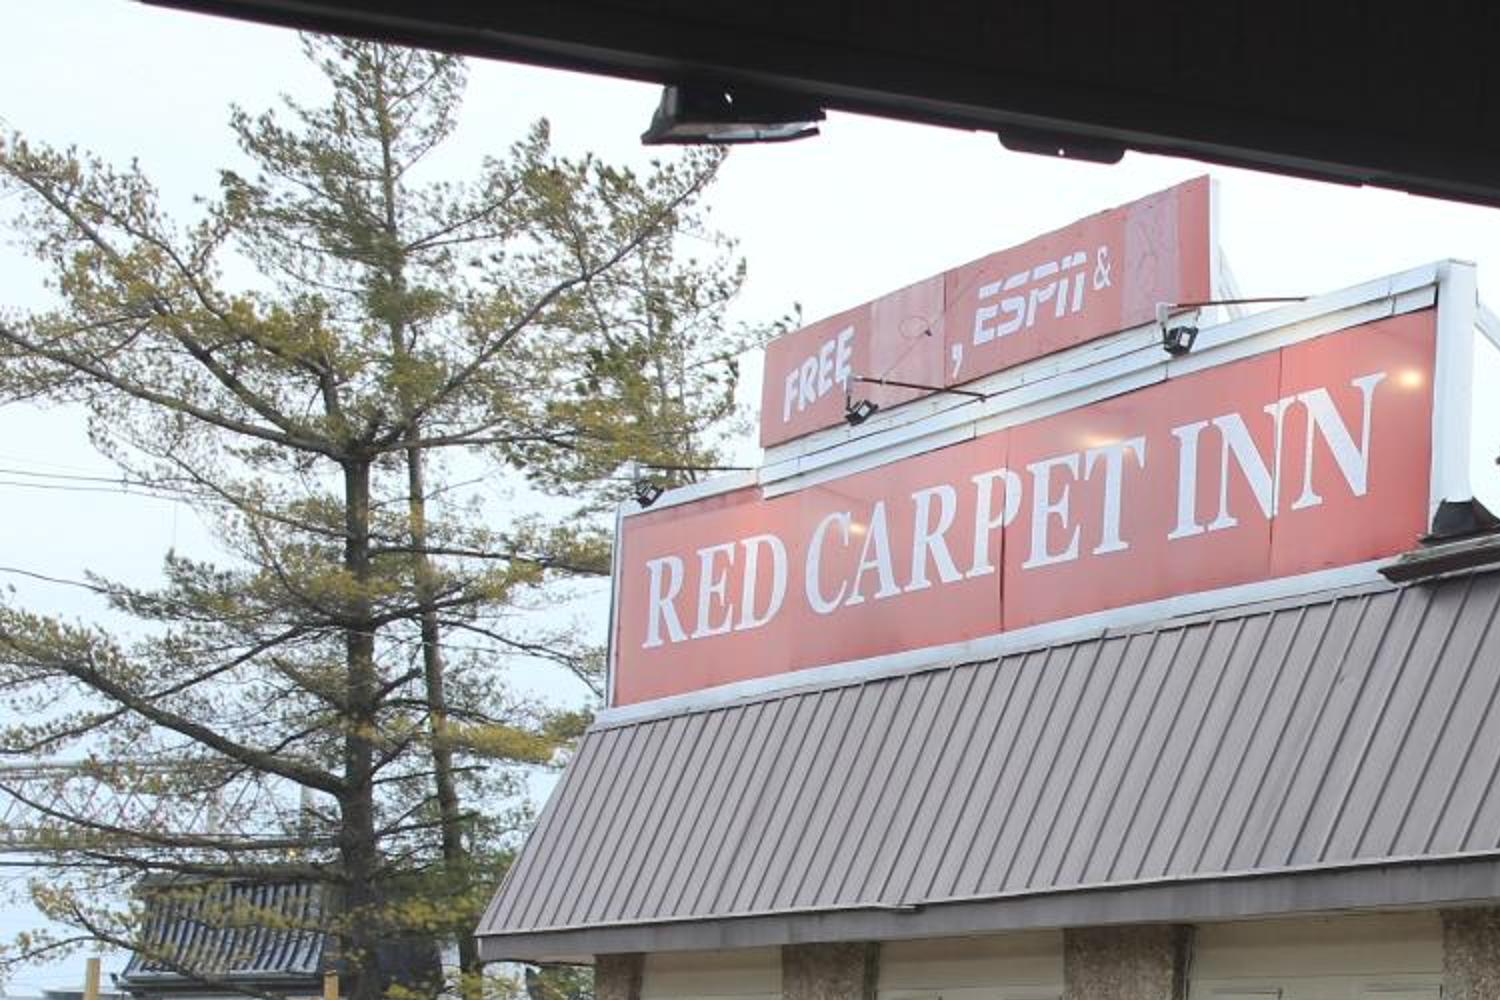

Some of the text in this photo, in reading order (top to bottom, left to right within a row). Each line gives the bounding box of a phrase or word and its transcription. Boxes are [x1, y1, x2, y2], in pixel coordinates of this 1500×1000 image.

[783, 325, 855, 422] FREE
[973, 251, 1088, 346] ESPN
[1093, 245, 1111, 290] &
[642, 372, 1387, 648] RED CARPET INN
